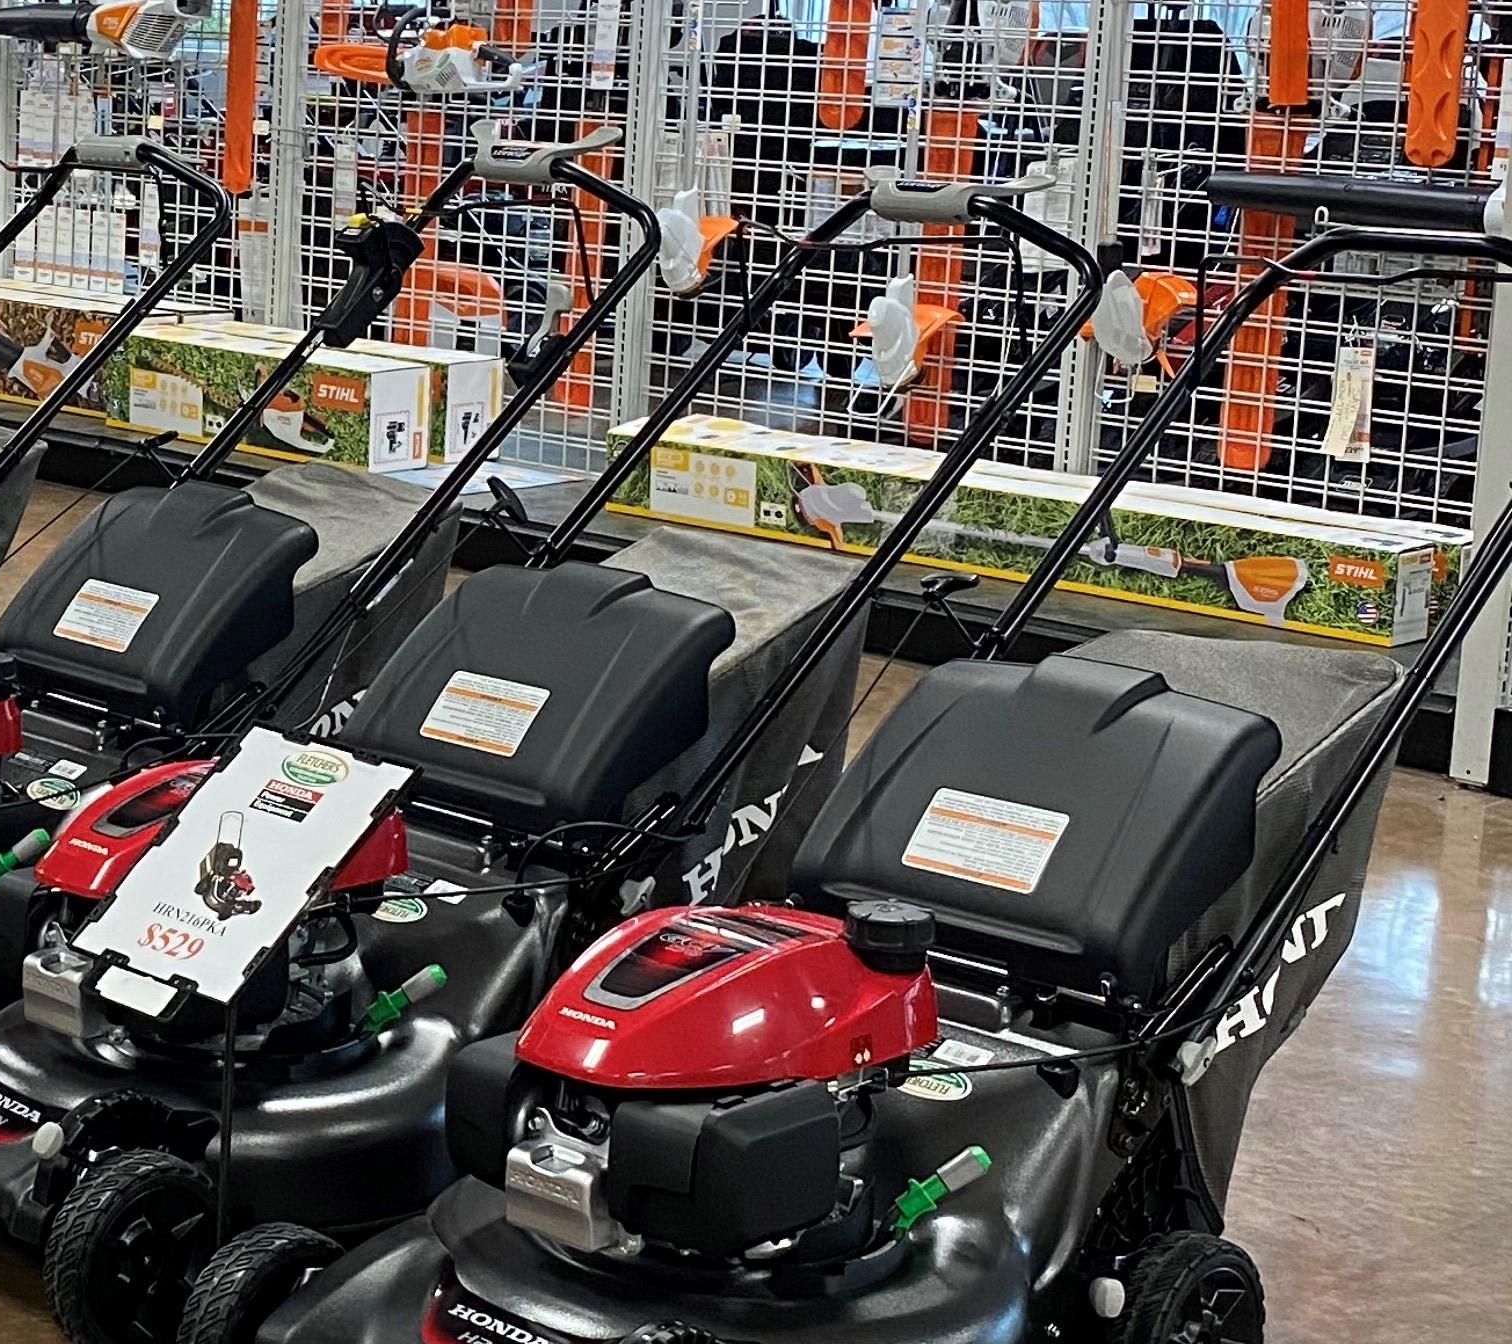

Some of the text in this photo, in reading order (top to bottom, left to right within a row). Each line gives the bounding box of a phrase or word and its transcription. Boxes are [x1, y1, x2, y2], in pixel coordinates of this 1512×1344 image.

[317, 383, 359, 403] STIHL
[1334, 563, 1378, 580] STIHL
[269, 779, 314, 801] HONDA
[69, 838, 109, 856] HONDA
[152, 901, 229, 937] HRN216PKA
[137, 922, 206, 960] $529
[559, 1007, 616, 1030] HONDA
